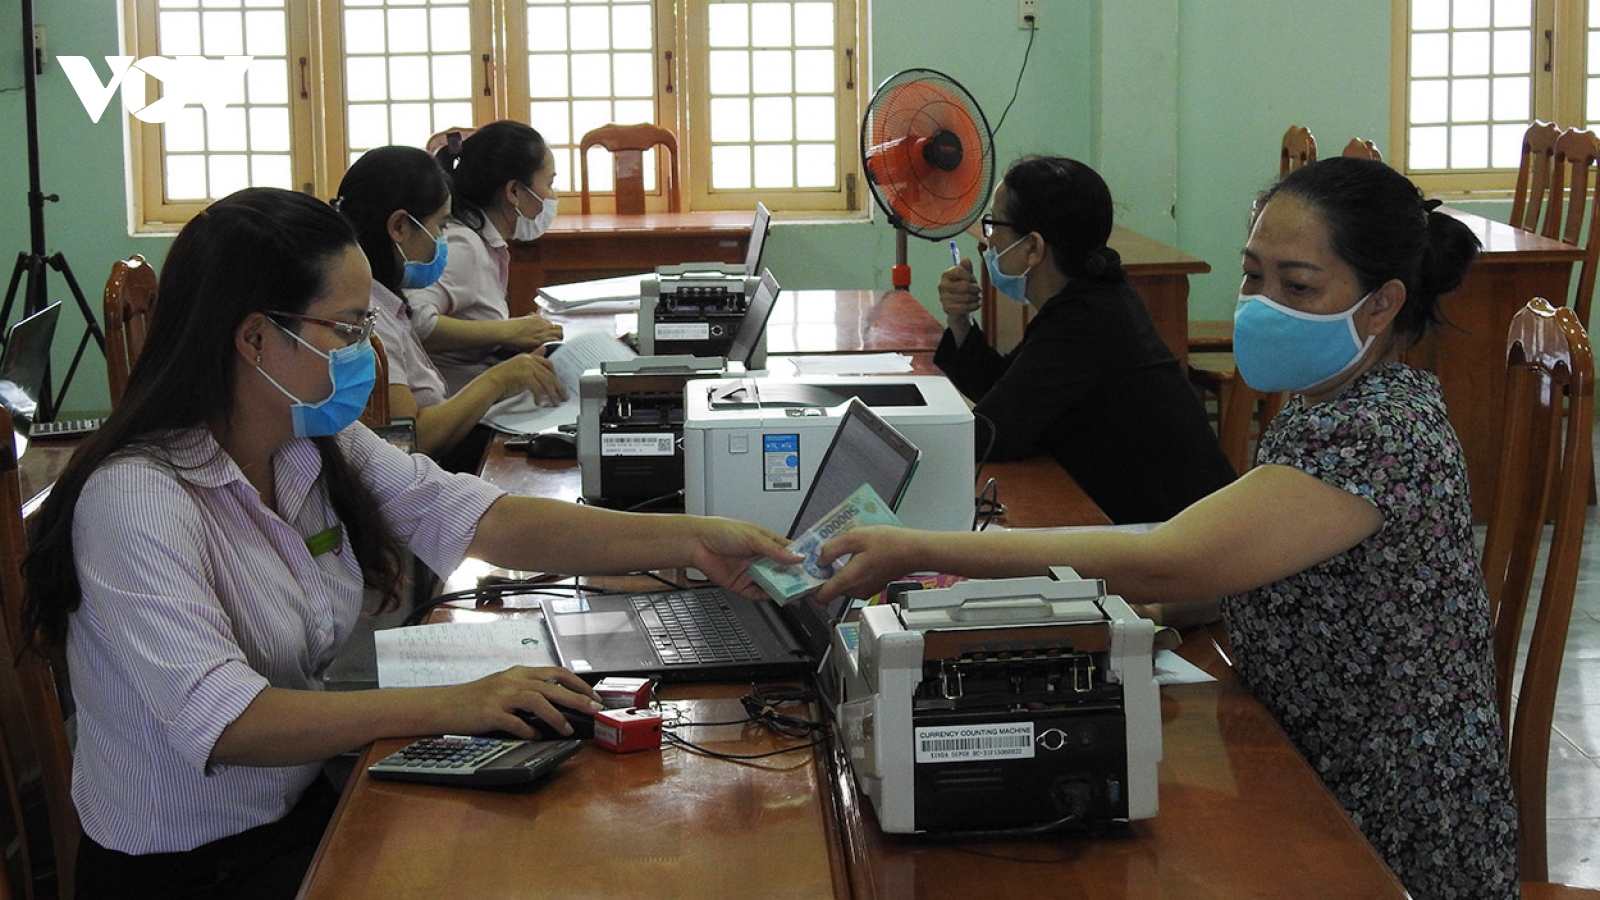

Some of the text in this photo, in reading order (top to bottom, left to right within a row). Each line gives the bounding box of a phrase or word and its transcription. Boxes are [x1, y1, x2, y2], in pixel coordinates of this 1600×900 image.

[818, 504, 861, 540] 500000
[919, 726, 1031, 739] CURRENCY COUNTING MACHINE
